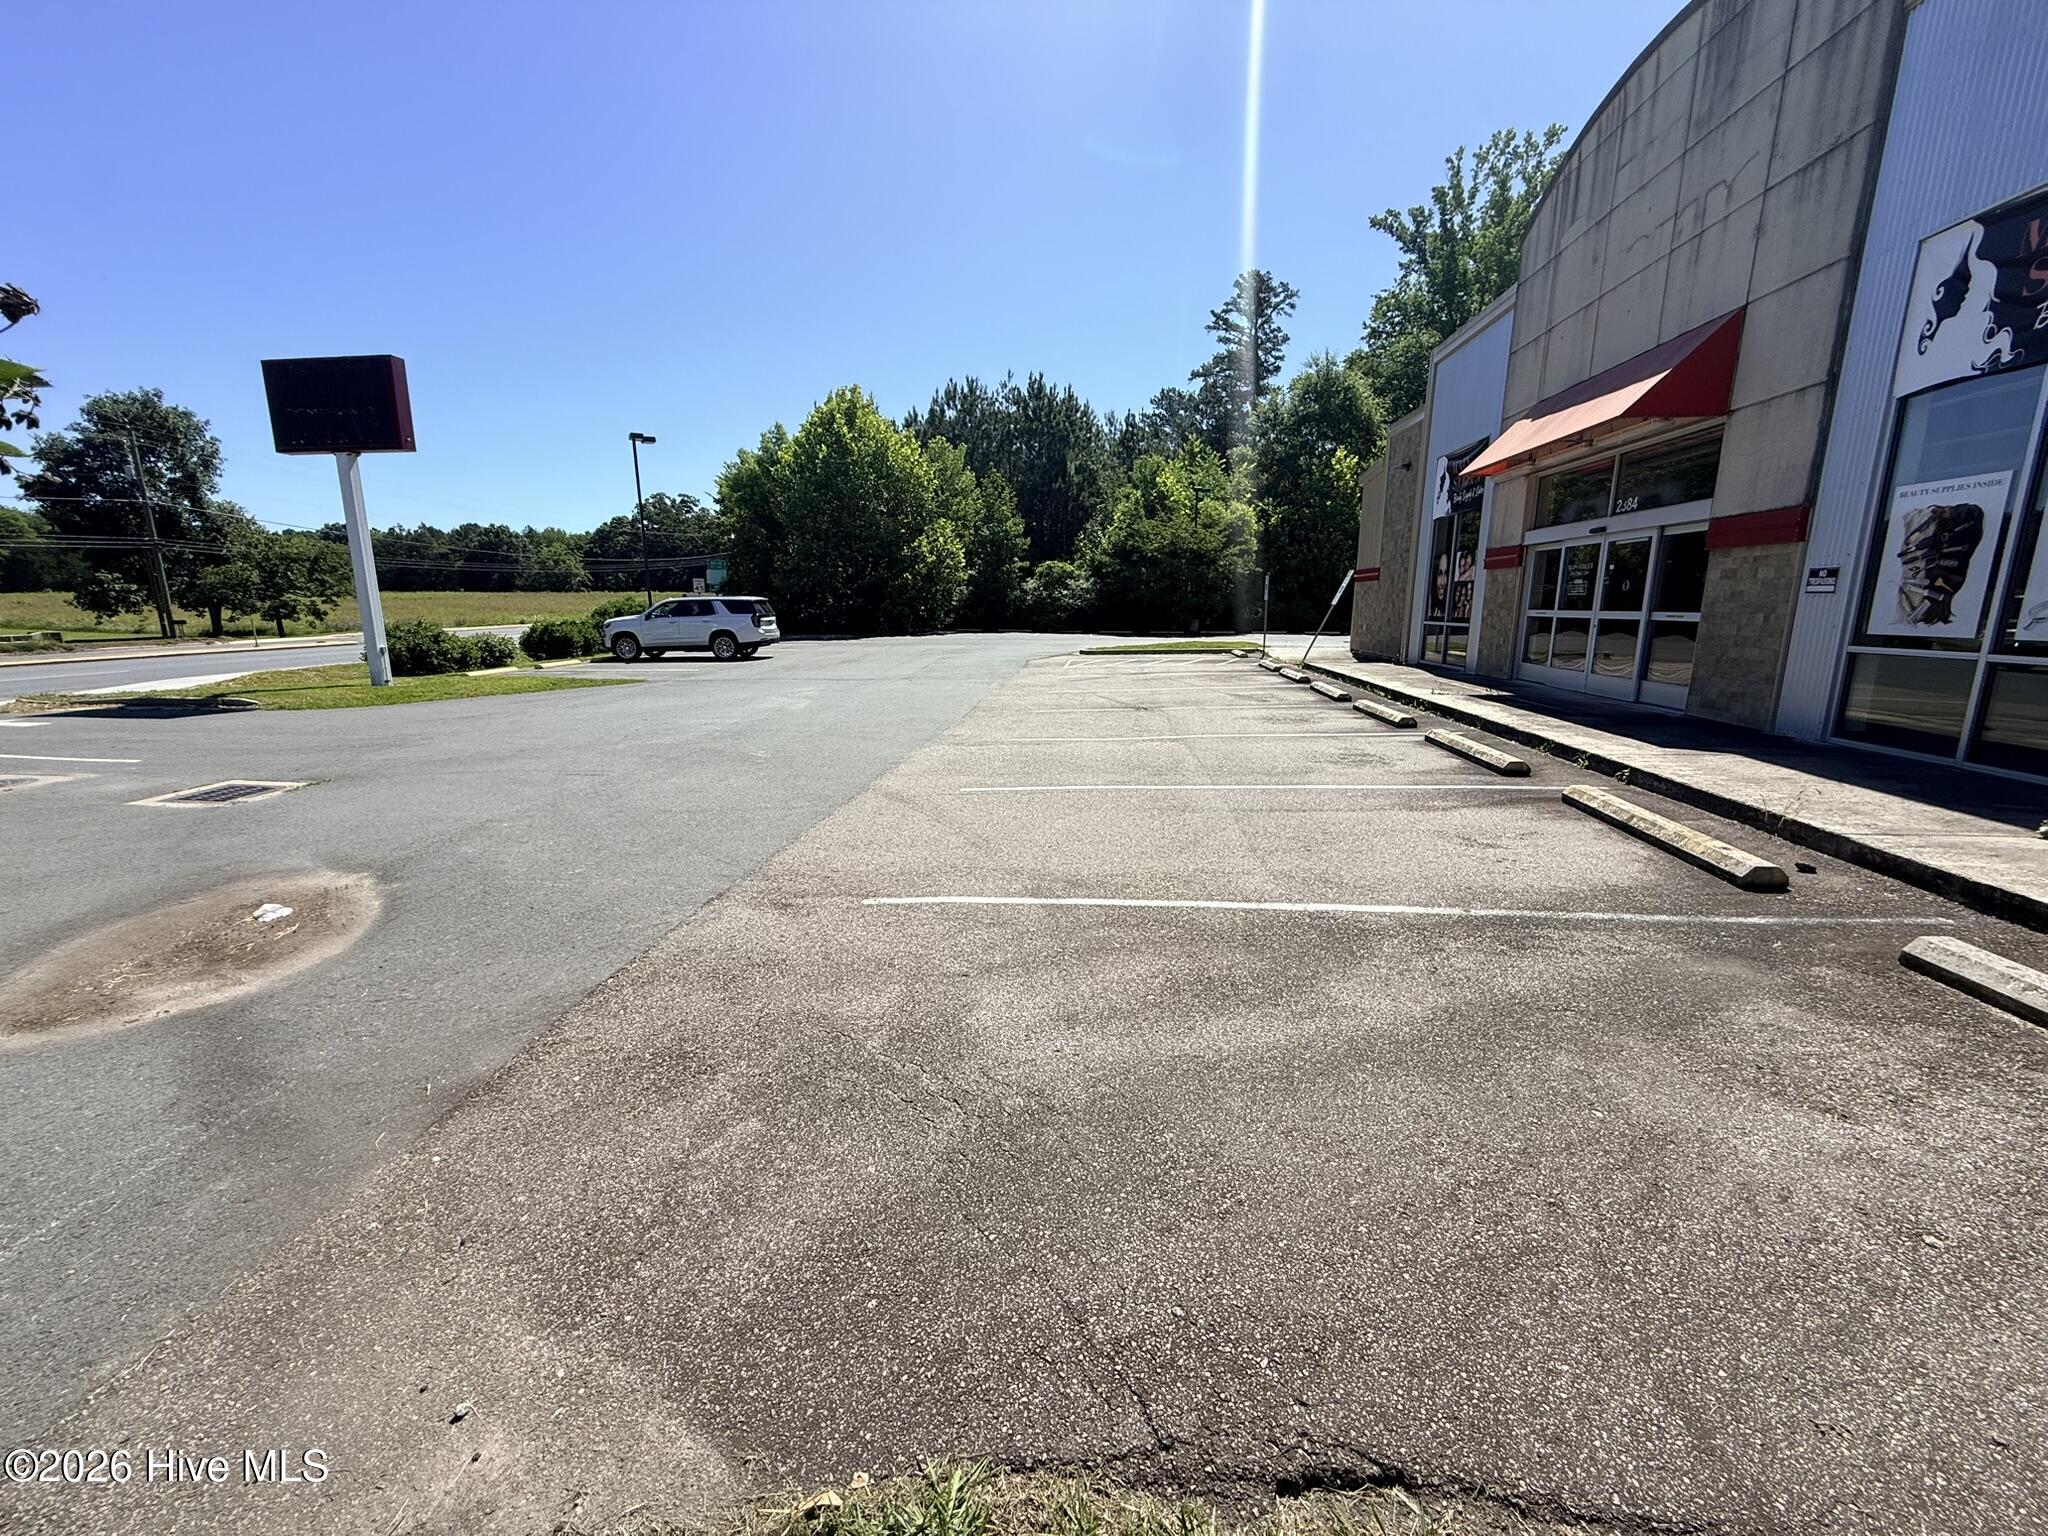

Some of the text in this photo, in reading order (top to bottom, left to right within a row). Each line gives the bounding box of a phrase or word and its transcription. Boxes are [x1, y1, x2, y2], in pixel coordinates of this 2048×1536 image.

[1899, 478, 2004, 499] BEAUTY SUPPLIES INSIDE
[1819, 569, 1828, 578] NO
